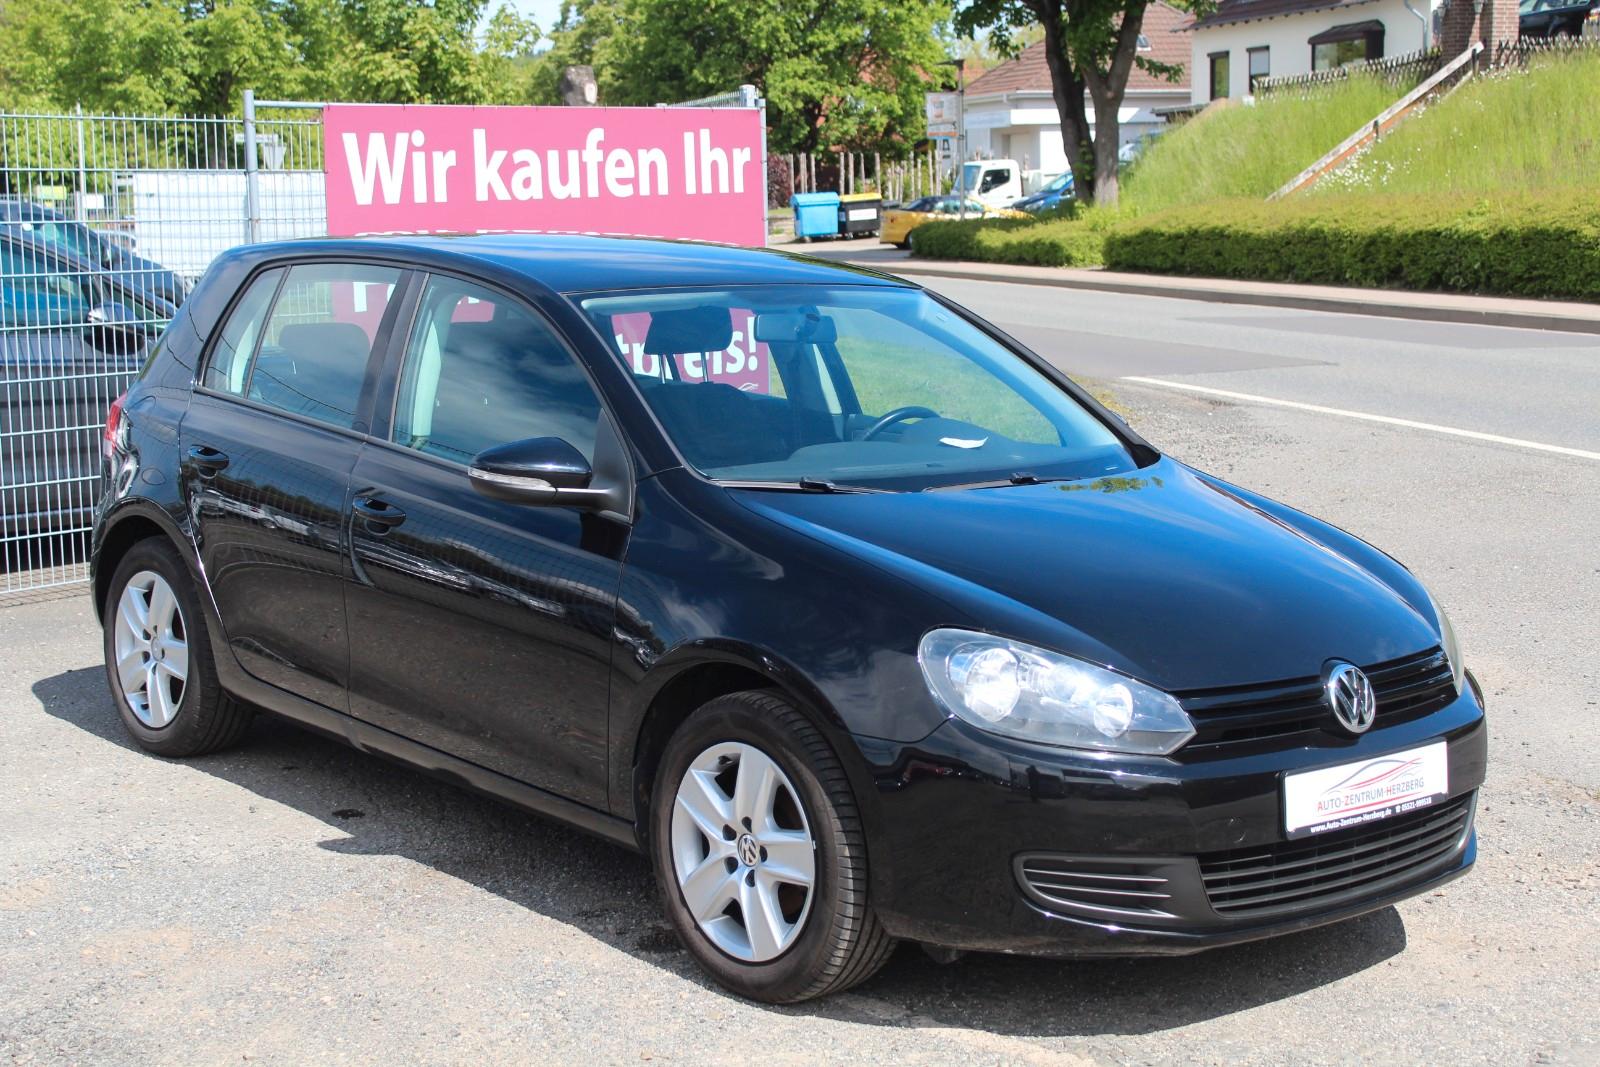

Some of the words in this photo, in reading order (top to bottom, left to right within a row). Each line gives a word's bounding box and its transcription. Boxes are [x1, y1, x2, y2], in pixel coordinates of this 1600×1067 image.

[342, 129, 456, 206] Wir
[473, 128, 668, 201] kaufen
[683, 128, 750, 195] Ihr
[1331, 665, 1375, 731] VW
[1317, 777, 1424, 811] AUTO-ZENTRUM-HERZBERG
